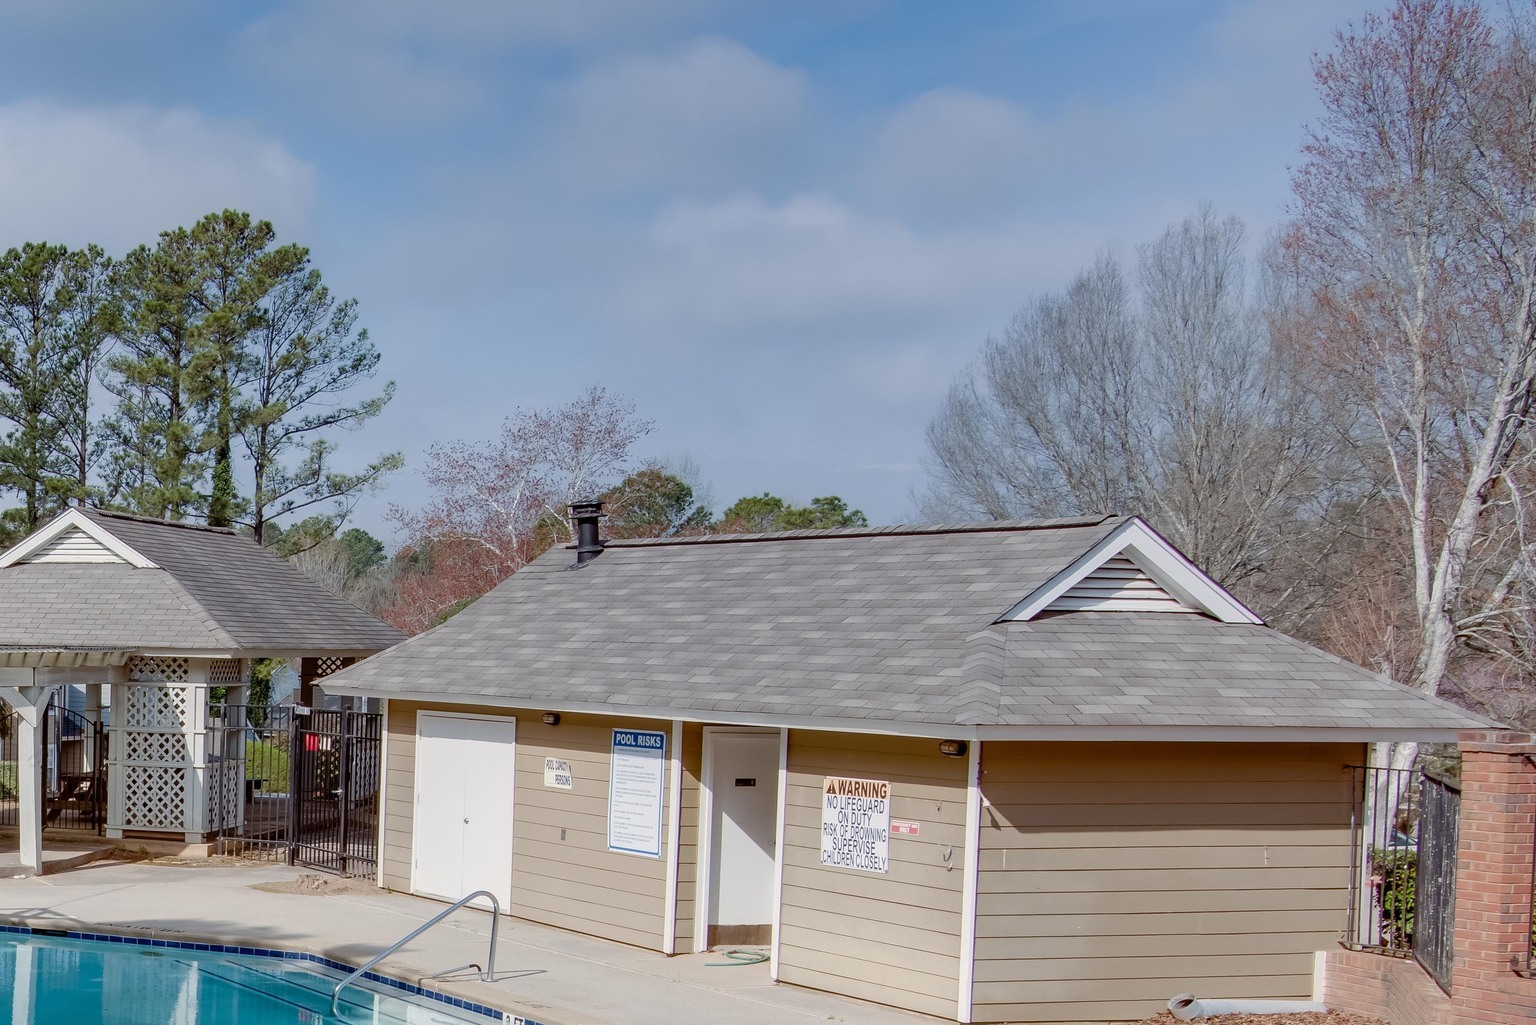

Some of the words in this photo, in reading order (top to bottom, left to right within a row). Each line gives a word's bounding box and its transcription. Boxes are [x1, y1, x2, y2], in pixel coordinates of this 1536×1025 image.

[616, 733, 635, 745] POOL
[638, 736, 661, 748] RISKS
[838, 780, 887, 799] WARNING
[827, 795, 838, 809] NO
[840, 797, 884, 814] LIFEGUARD
[838, 811, 848, 824] ON
[851, 812, 872, 826] DUTY
[824, 823, 837, 836] RISK
[840, 824, 848, 837] OF
[851, 826, 886, 842] DROWNING
[832, 837, 875, 855] SUPERVISE
[823, 850, 854, 866] CHILDREN
[856, 854, 886, 870] CLOSELY
